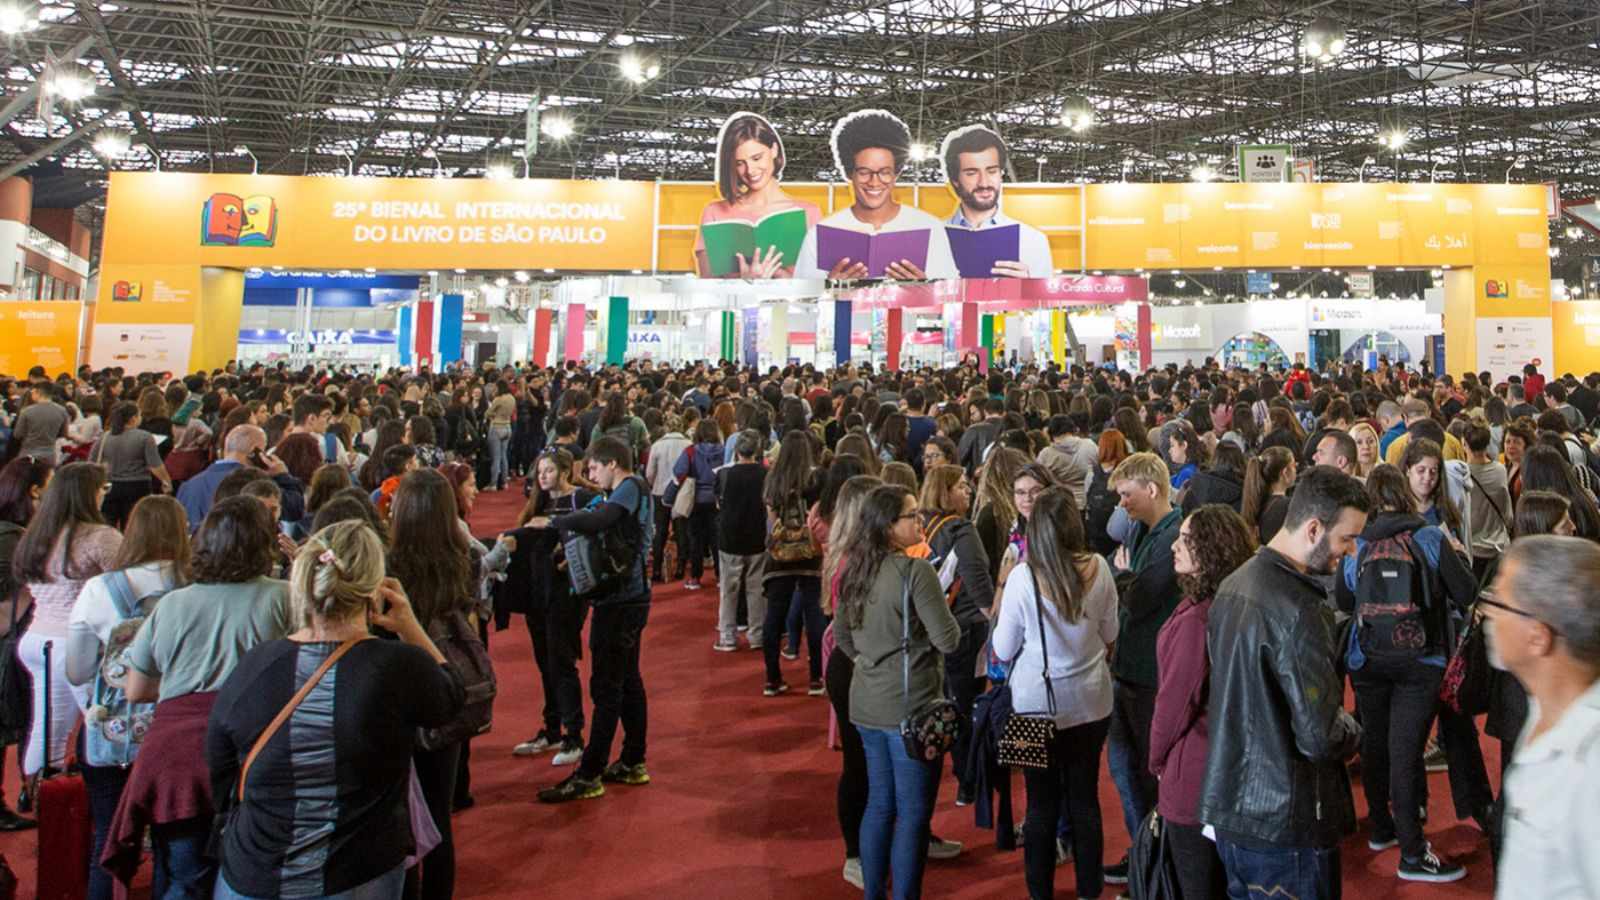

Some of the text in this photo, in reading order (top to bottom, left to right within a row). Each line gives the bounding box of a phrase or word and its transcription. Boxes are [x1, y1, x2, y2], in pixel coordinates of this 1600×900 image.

[371, 201, 444, 219] BIENAL
[455, 202, 625, 220] INTERNACIONAL
[354, 224, 607, 244] DO LIVRO DE SÃO PAULO
[628, 332, 661, 343] IXA
